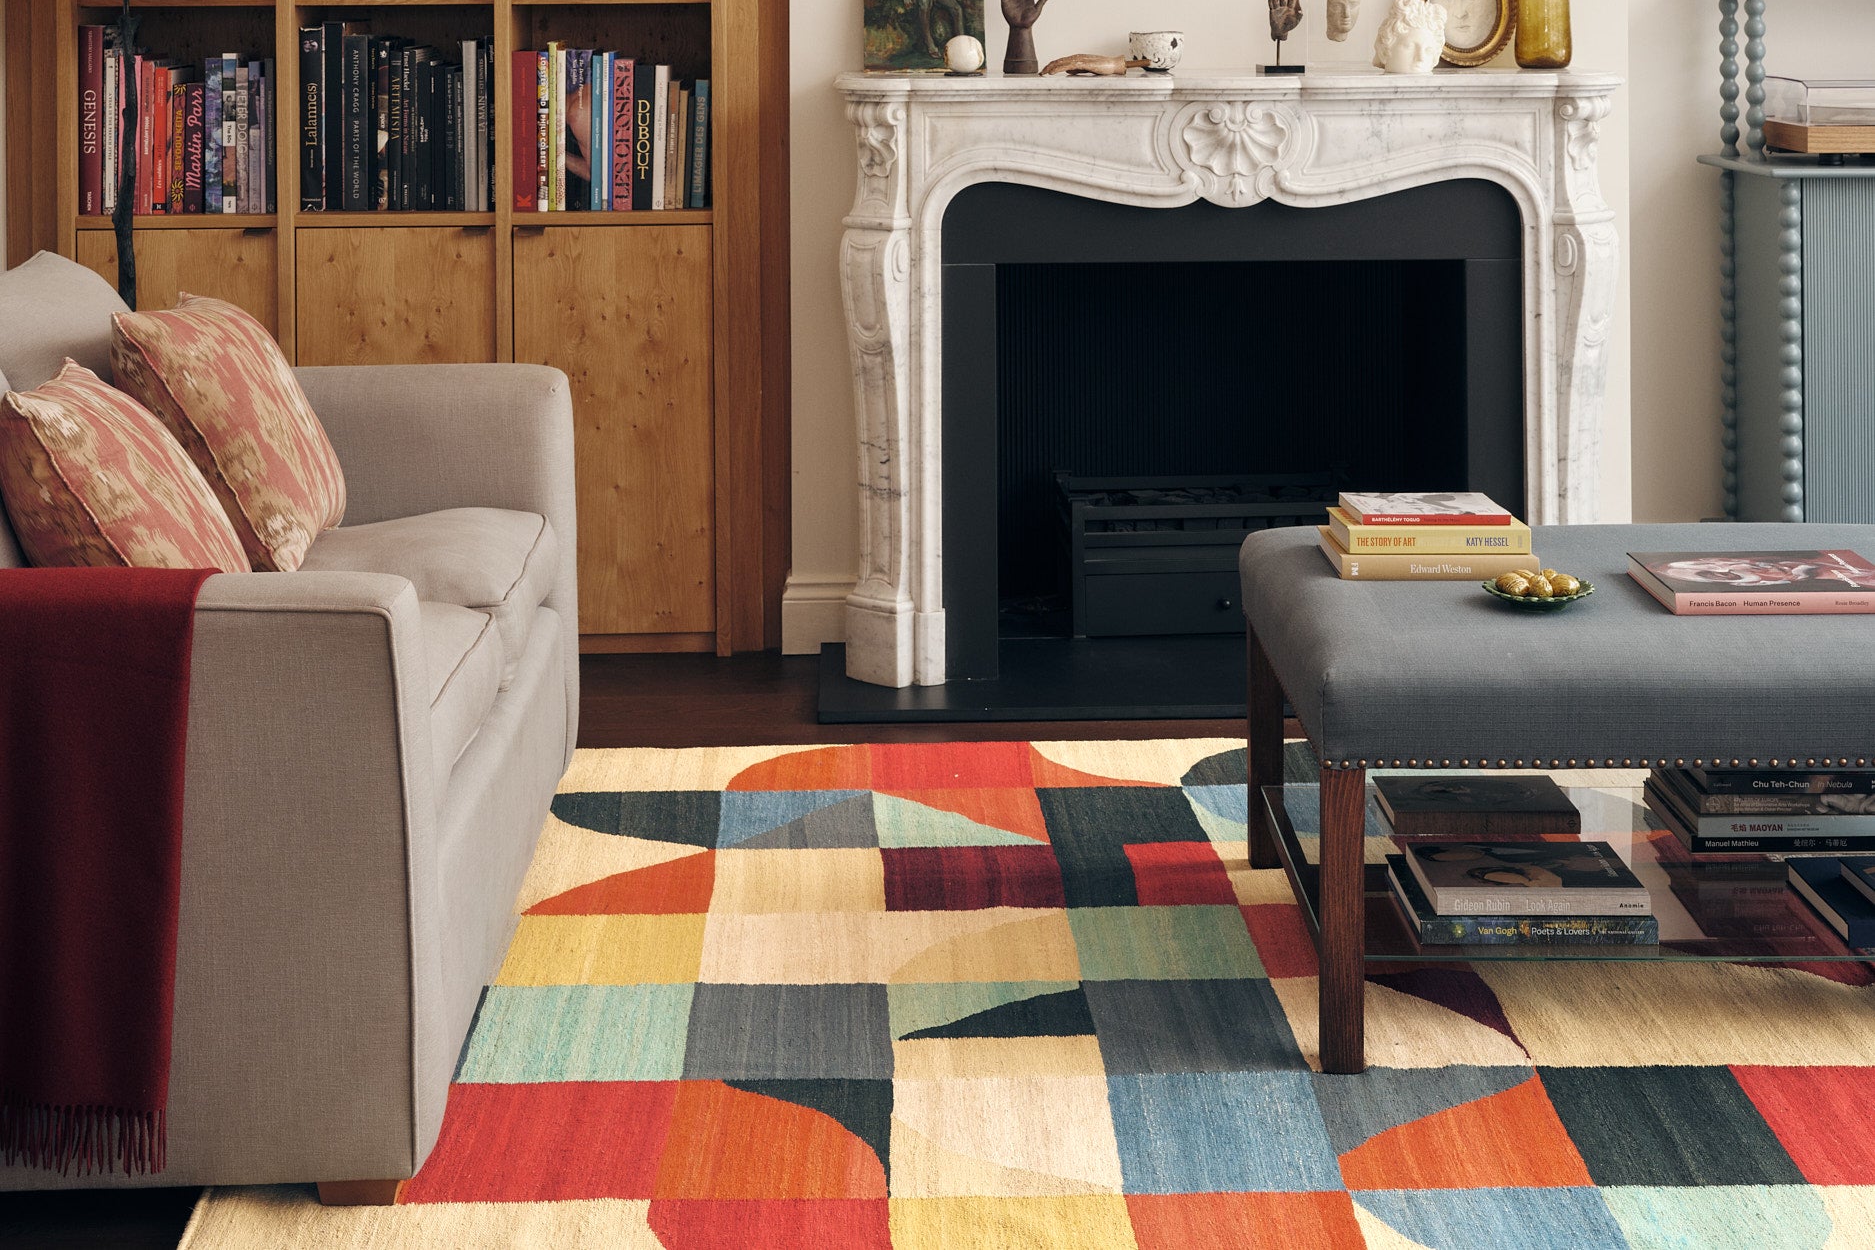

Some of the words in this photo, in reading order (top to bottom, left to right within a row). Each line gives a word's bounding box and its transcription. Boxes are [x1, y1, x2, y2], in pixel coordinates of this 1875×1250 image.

[188, 88, 203, 127] Parr
[237, 89, 246, 119] PETER
[392, 76, 400, 140] ARTEMISIA
[697, 96, 706, 122] GENS
[84, 90, 96, 154] GENESIS
[304, 82, 318, 146] Lalanne(s)
[478, 121, 486, 132] LA
[696, 126, 704, 144] DES
[238, 123, 248, 153] DOIG
[636, 100, 650, 180] DUBOUT
[353, 144, 359, 152] OF
[186, 132, 202, 189] Martin
[1356, 537, 1368, 546] THE
[1370, 537, 1392, 546] STORY
[1393, 537, 1402, 546] OF
[1402, 537, 1416, 546] ART
[1466, 537, 1482, 546] KATY
[1484, 537, 1509, 546] HESSEL
[1351, 562, 1358, 576] FM
[1410, 564, 1441, 574] Edward
[1442, 564, 1472, 574] Weston
[1752, 780, 1768, 788] Chu
[1770, 780, 1810, 788] Teh-Chun
[1454, 899, 1484, 912] Gideon
[1486, 899, 1510, 911] Rubin
[1526, 899, 1546, 911] Look
[1547, 900, 1571, 912] Again
[1478, 926, 1494, 934] Van
[1496, 926, 1518, 936] Gogh
[1532, 926, 1554, 936] Poets
[1556, 927, 1562, 935] &
[1564, 926, 1590, 936] Lovers
